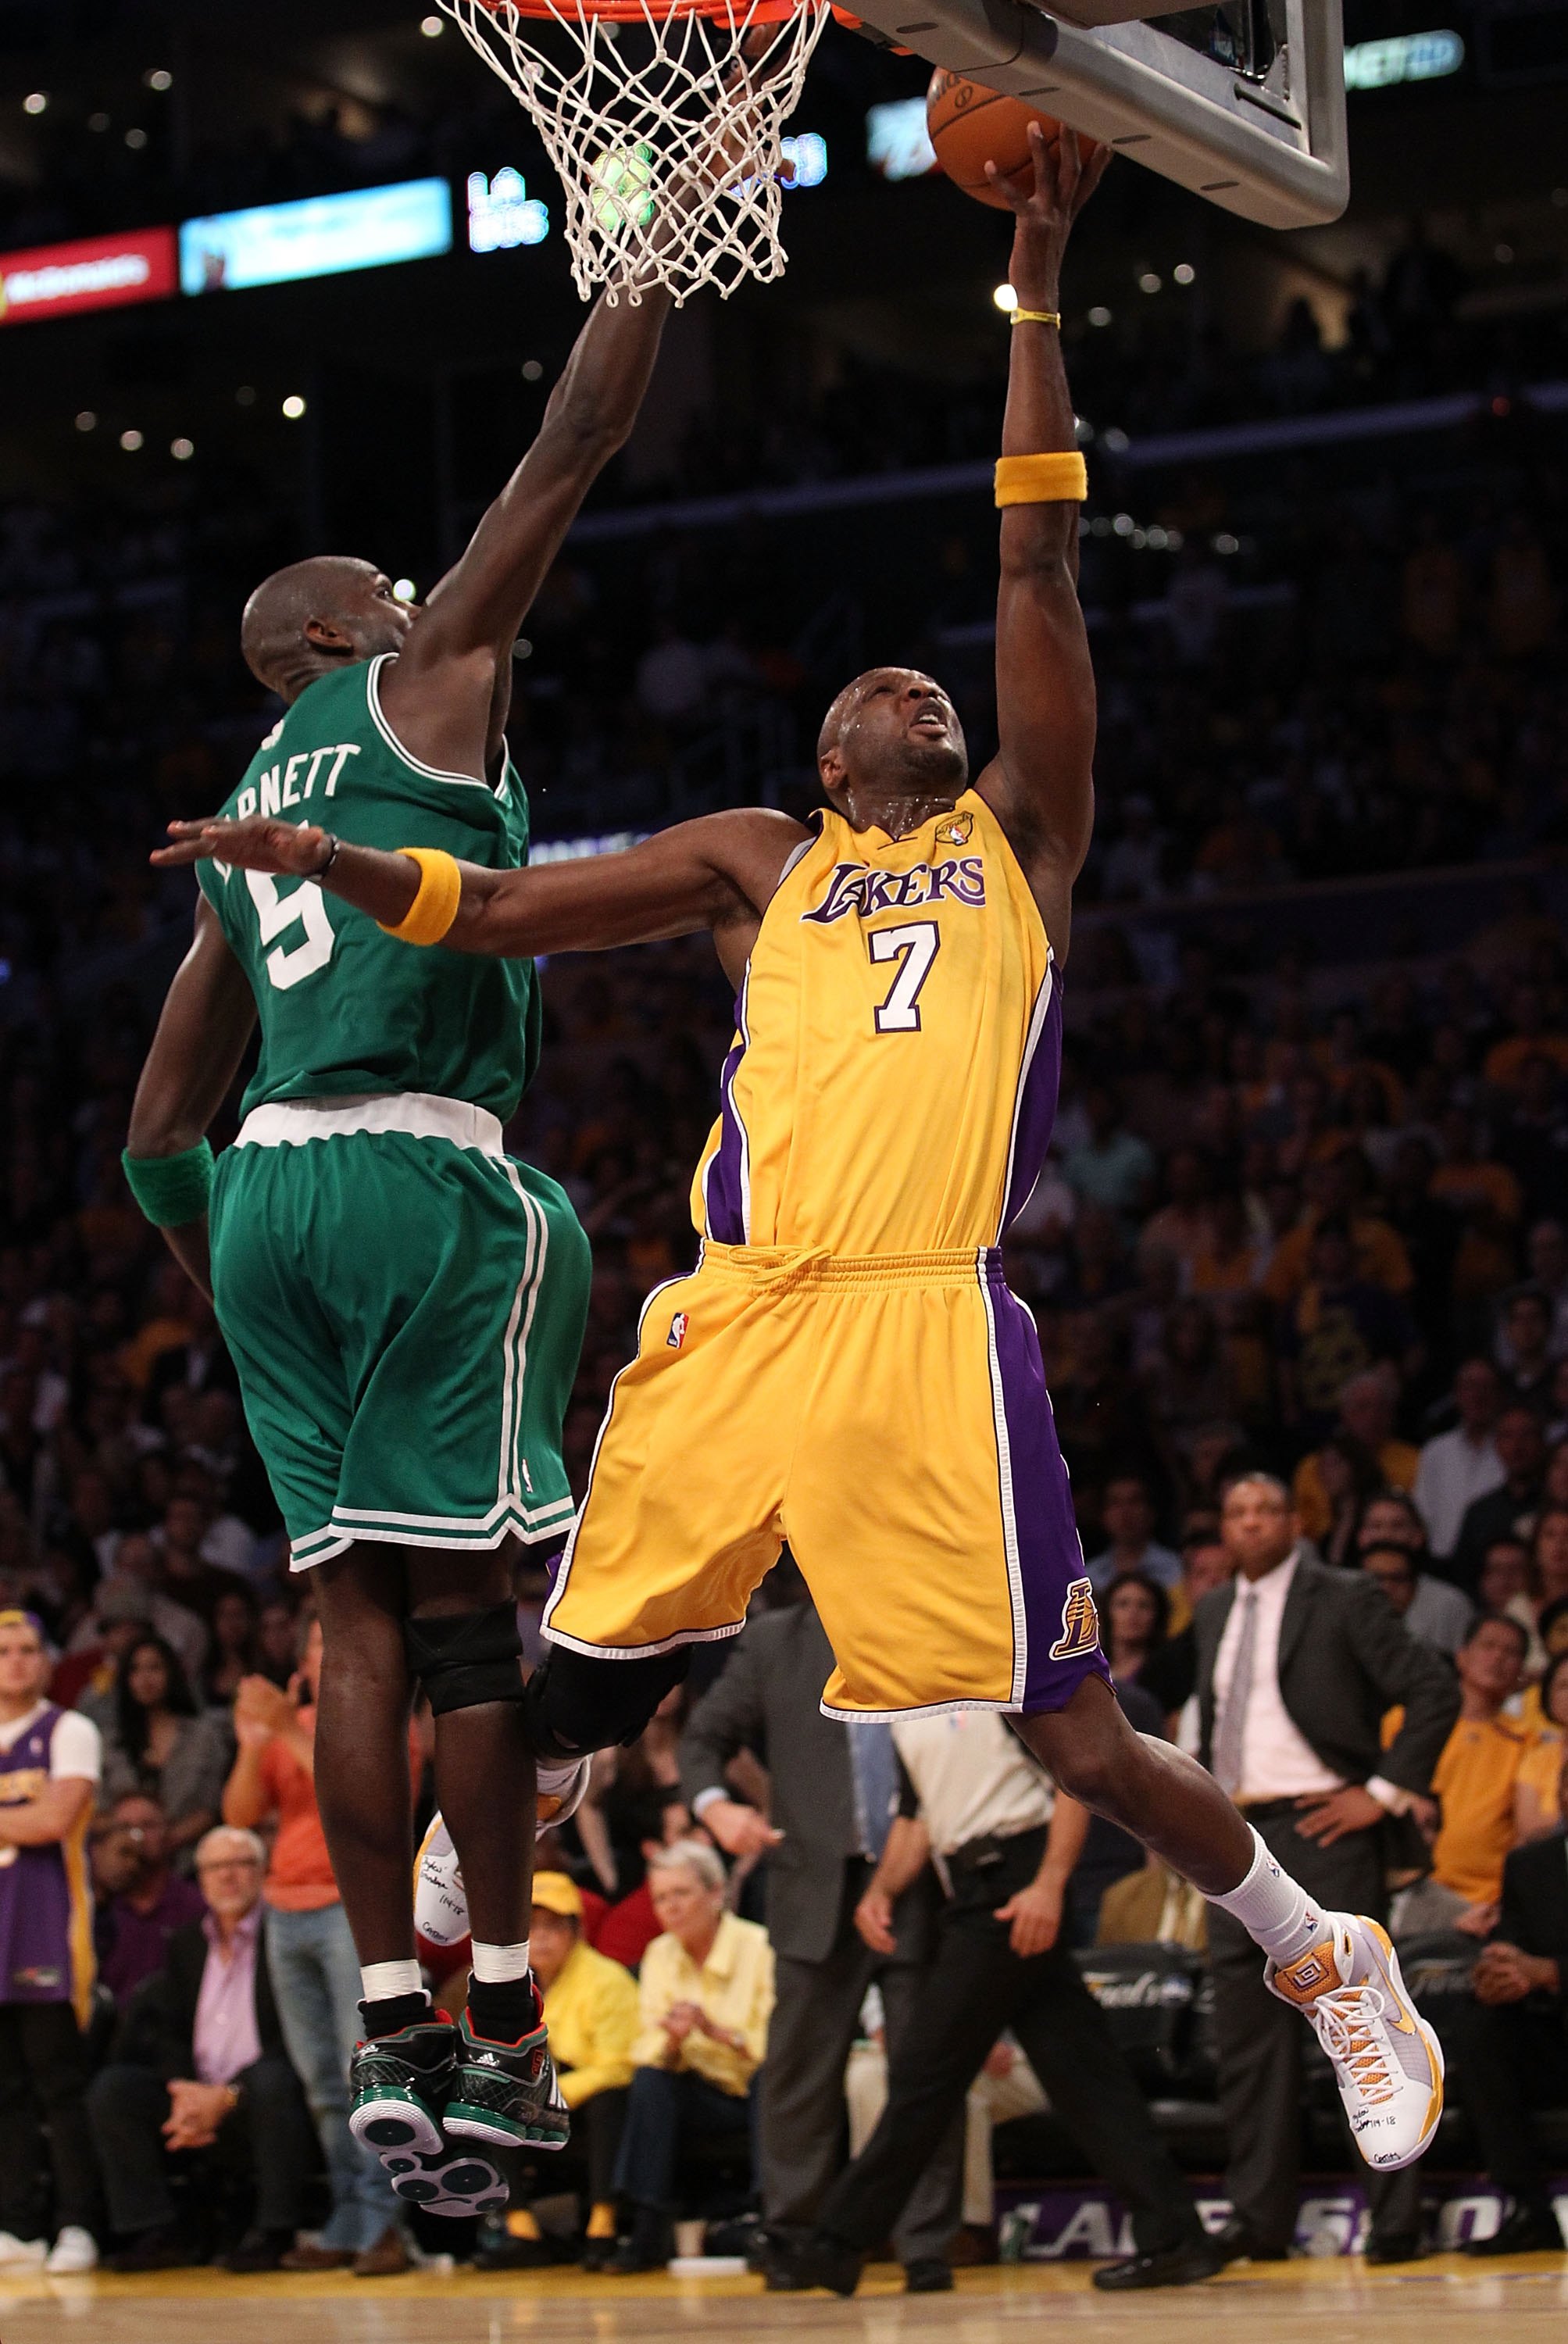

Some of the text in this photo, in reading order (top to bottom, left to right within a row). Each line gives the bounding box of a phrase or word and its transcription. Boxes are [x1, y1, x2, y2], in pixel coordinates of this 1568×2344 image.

[218, 743, 362, 840] RNETT
[245, 820, 335, 991] 5
[799, 856, 986, 924] LAKERS
[867, 920, 941, 1034] 7
